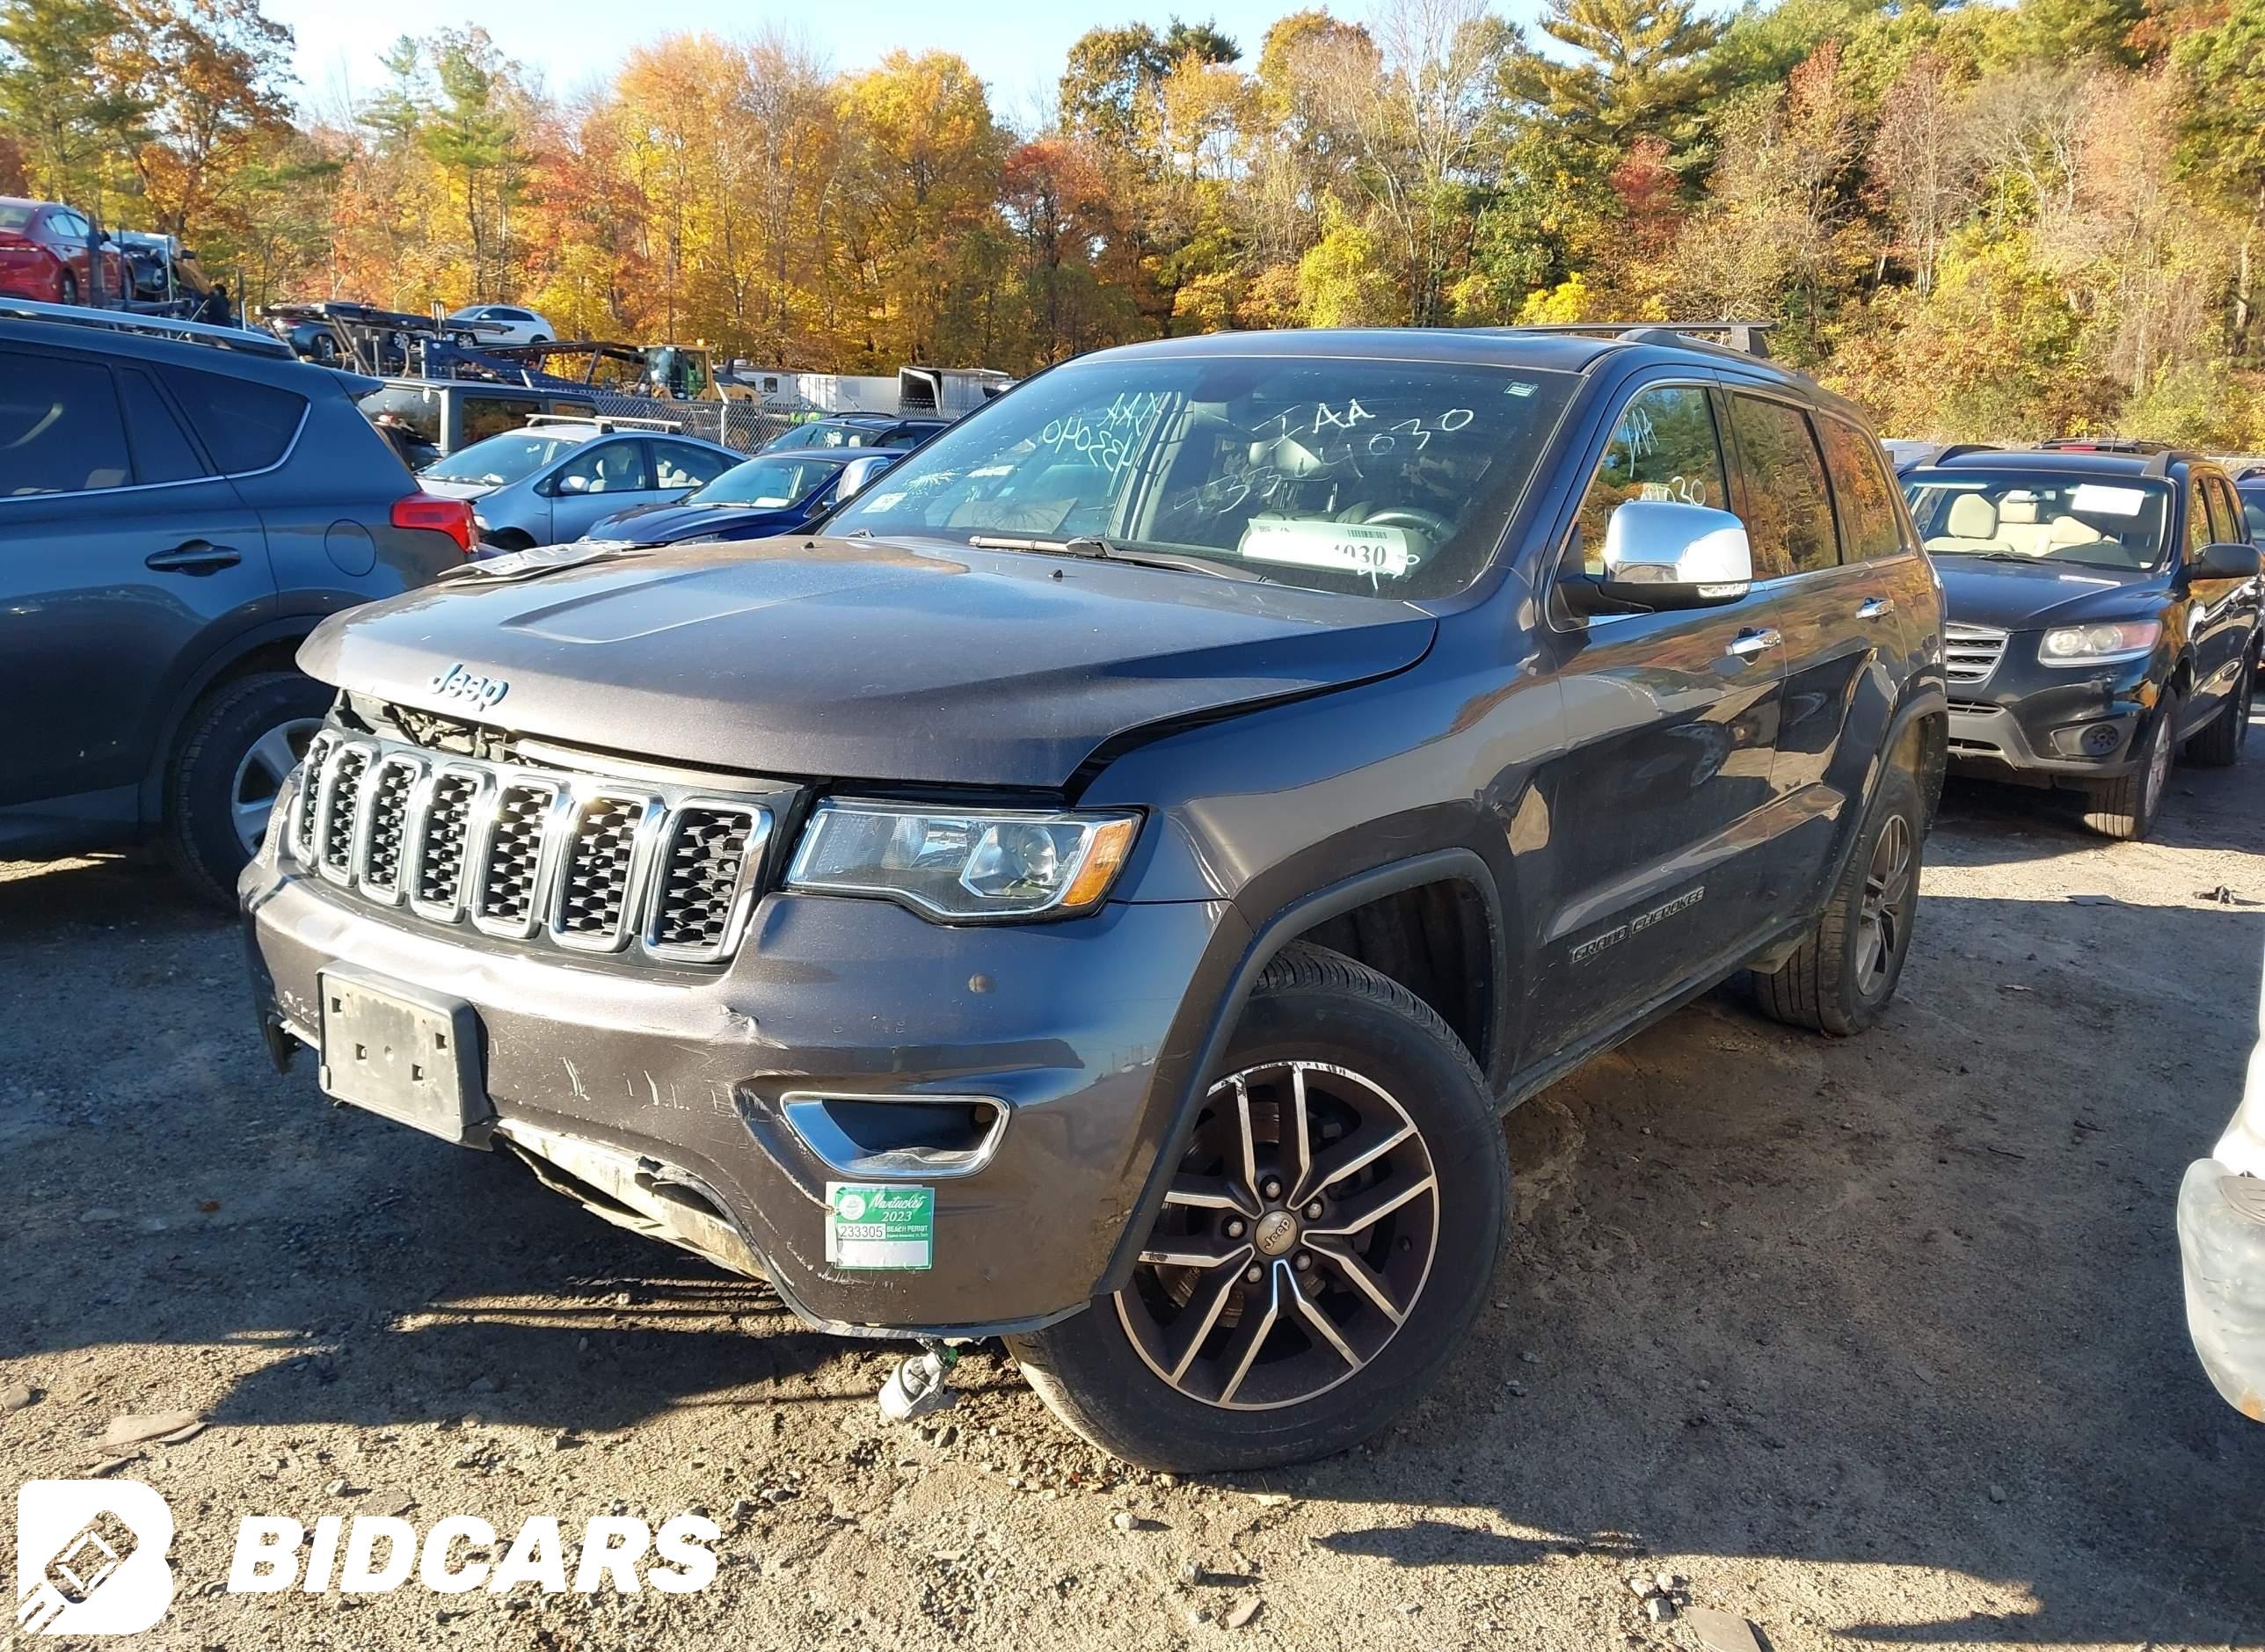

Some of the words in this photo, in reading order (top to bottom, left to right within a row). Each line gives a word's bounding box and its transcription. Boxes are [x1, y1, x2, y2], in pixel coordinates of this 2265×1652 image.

[430, 662, 509, 712] Jeep
[1571, 925, 1628, 963] GRAND
[1632, 886, 1706, 935] CHEROKEE
[868, 1192, 928, 1209] Nantucket
[881, 1212, 913, 1222] 2023
[840, 1226, 883, 1238] 233305
[1265, 1219, 1290, 1249] Jeep
